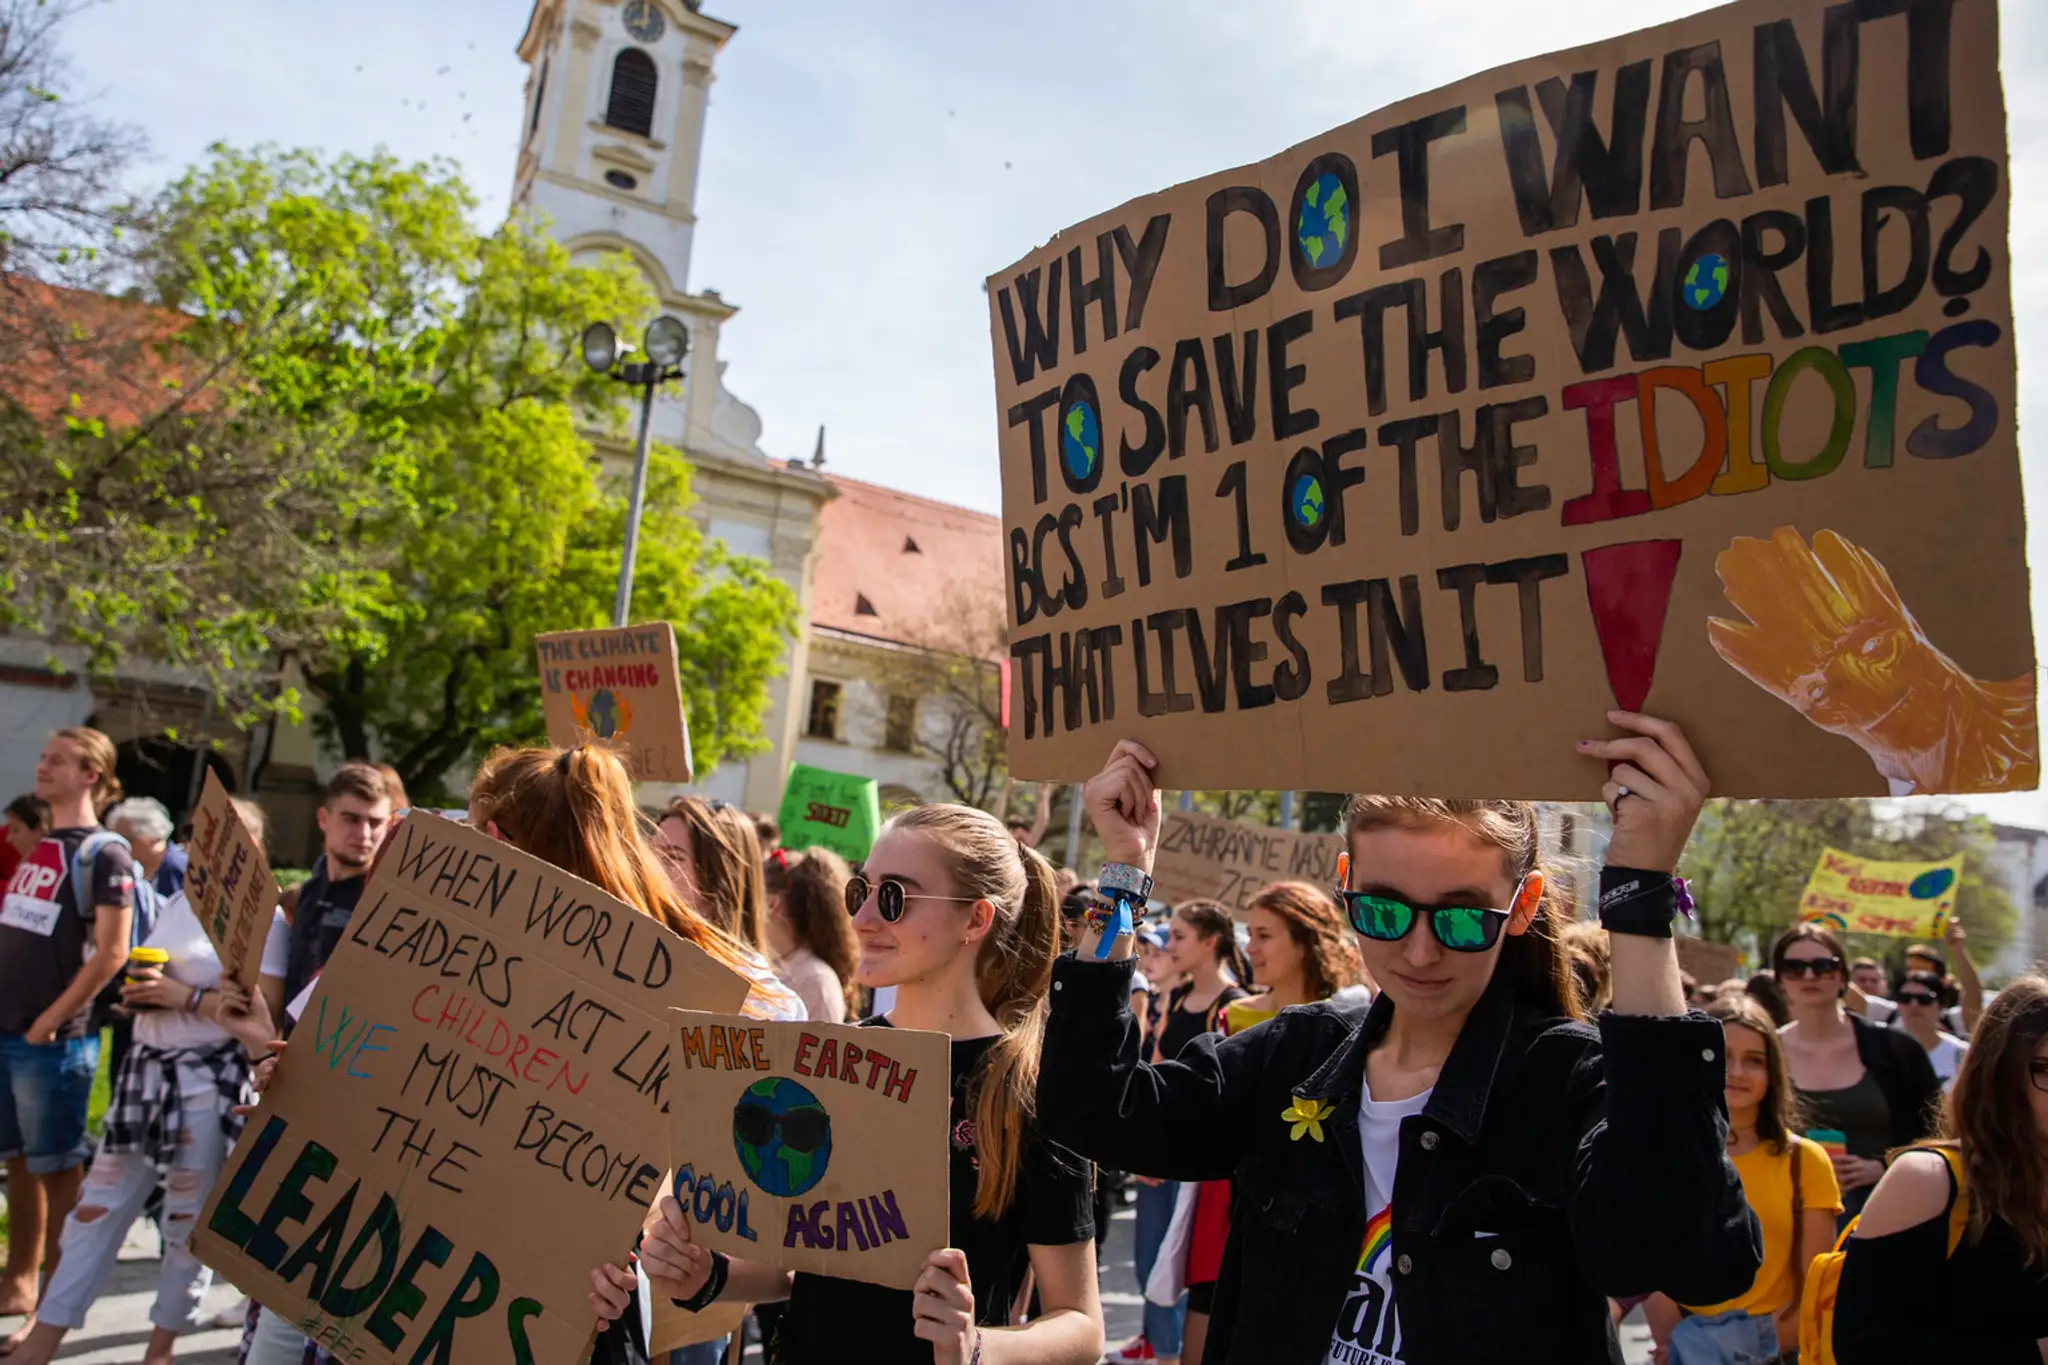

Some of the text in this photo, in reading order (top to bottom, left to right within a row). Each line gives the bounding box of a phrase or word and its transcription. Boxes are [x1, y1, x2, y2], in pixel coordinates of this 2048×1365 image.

[997, 0, 1952, 387] WHY DO I WANT
[1007, 155, 1999, 504] TO SAVE THE WORLD?
[1011, 318, 2000, 628] BCS I'M 1 OF THE IDIOTS
[539, 631, 660, 664] THE CLIMATE
[566, 663, 659, 692] CHANGING
[1011, 624, 1122, 742] THAT
[1132, 590, 1311, 719] LIVES
[1326, 573, 1430, 706] IN
[7, 863, 57, 898] TOP
[396, 823, 671, 990] WHEN WORLD
[1216, 868, 1266, 912] ZE
[352, 899, 671, 1114] LEADERS ACT LIK
[412, 984, 590, 1096] CHILDREN
[313, 995, 660, 1208] WE MUST BECOME
[681, 1025, 917, 1103] MAKE EARTH
[371, 1107, 482, 1194] THE
[675, 1163, 910, 1251] COOL AGAIN
